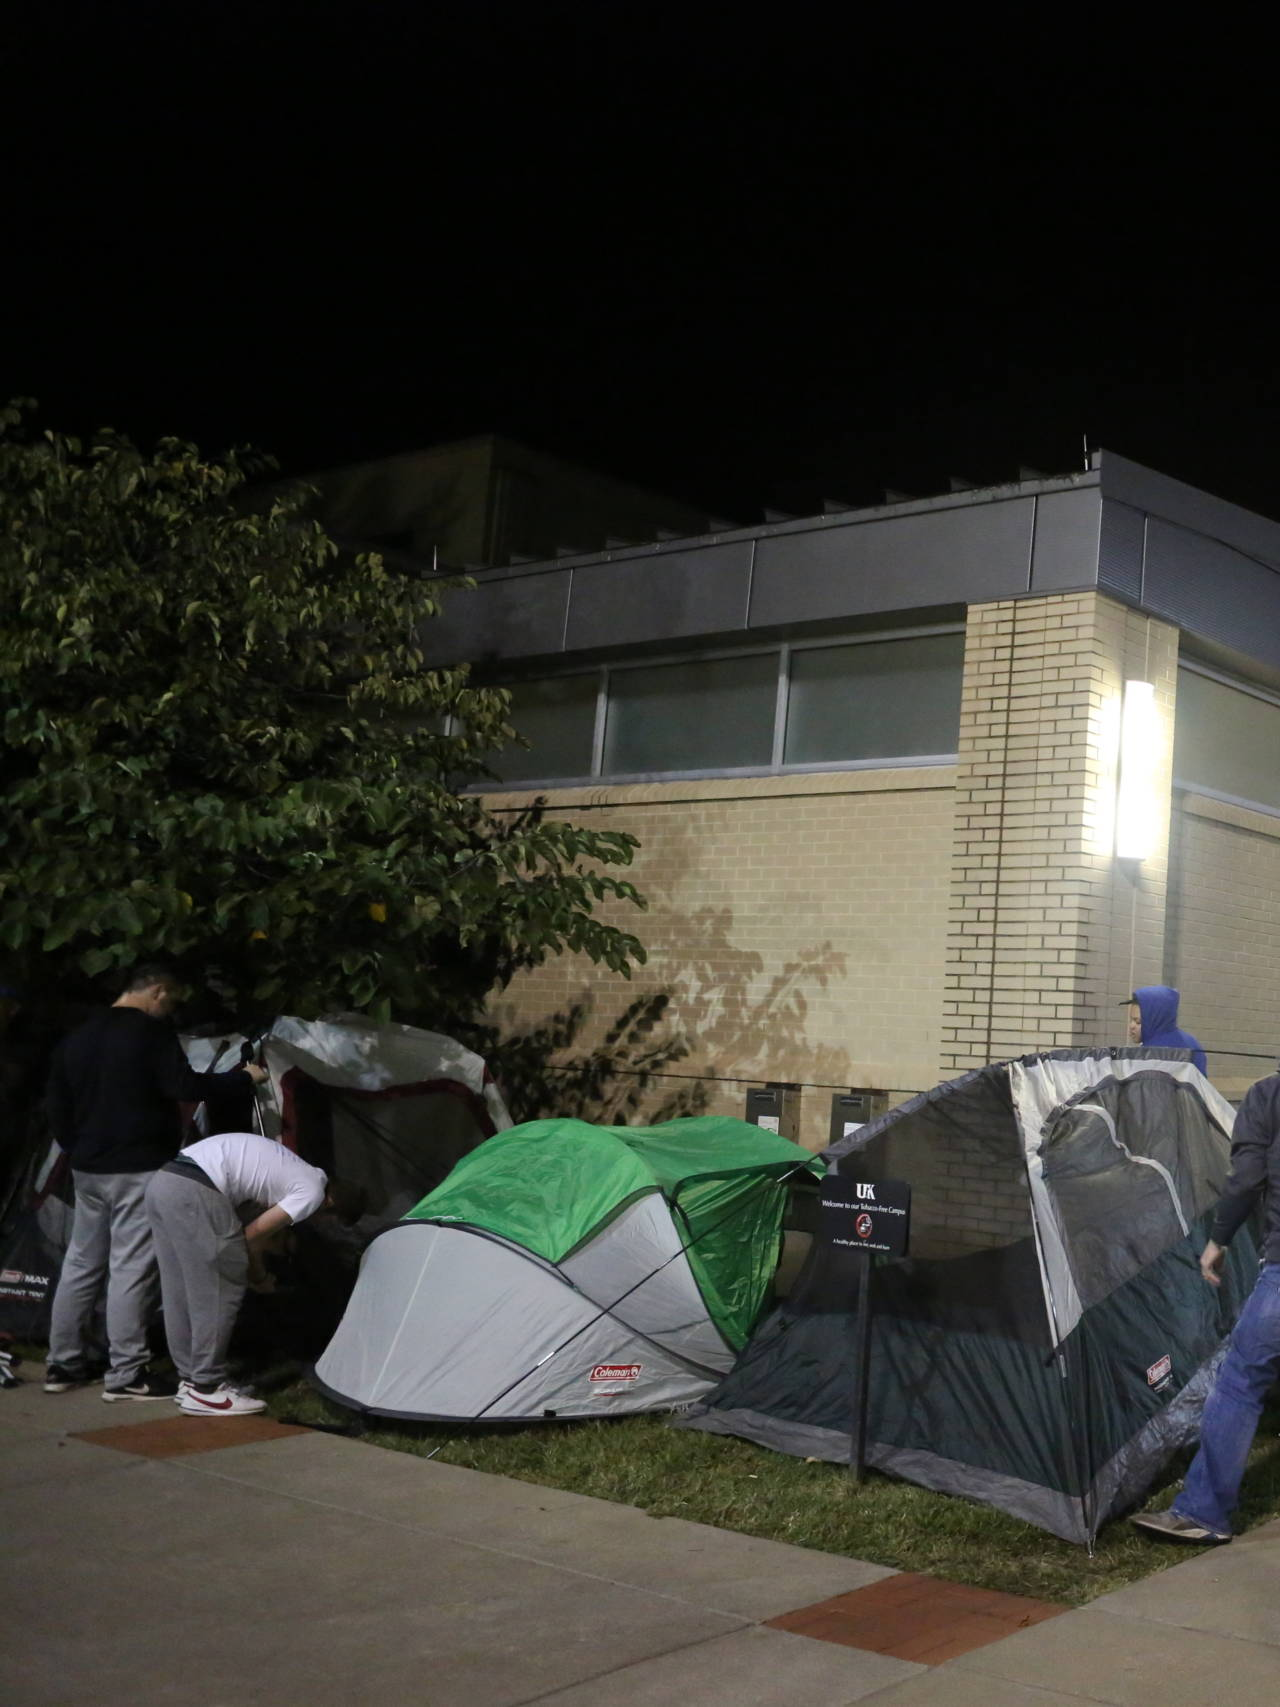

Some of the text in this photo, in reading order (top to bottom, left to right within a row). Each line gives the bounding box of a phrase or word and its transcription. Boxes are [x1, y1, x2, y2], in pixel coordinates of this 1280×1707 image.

[855, 1183, 876, 1200] UK
[822, 1200, 844, 1208] Welcome
[888, 1206, 906, 1216] Campus
[24, 1274, 50, 1285] MAX
[28, 1290, 45, 1299] TENT
[594, 1366, 631, 1378] Coleman
